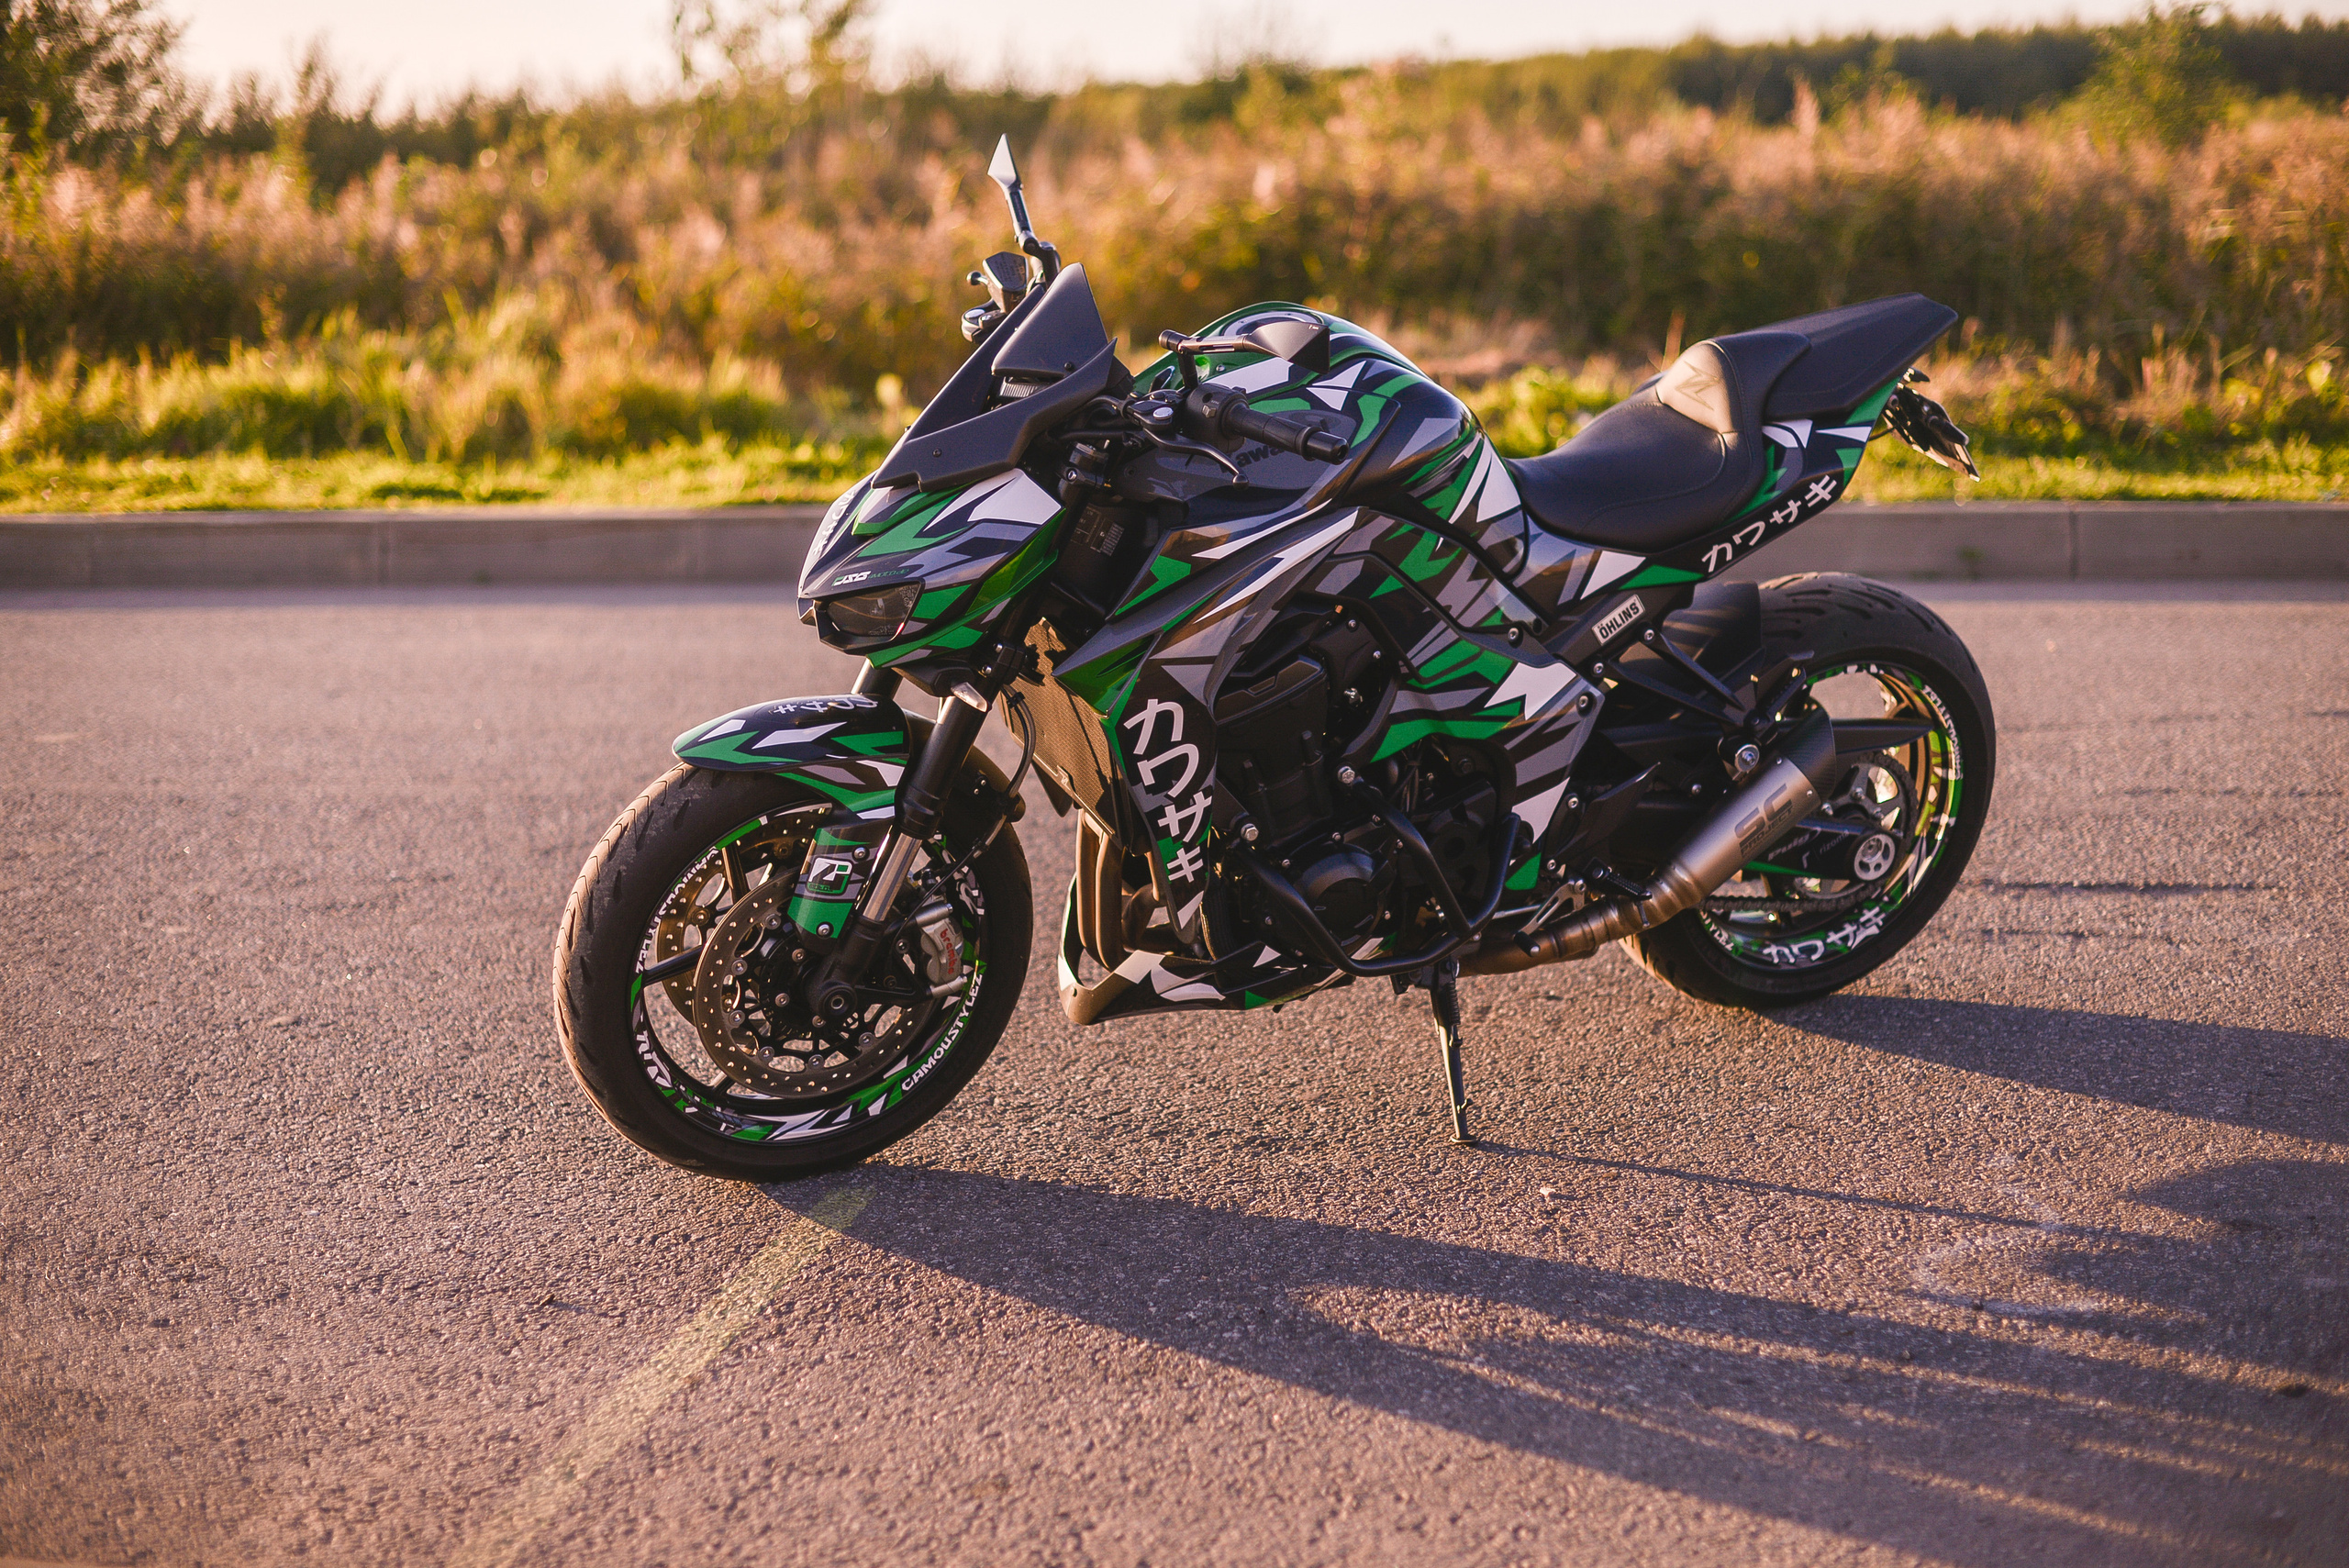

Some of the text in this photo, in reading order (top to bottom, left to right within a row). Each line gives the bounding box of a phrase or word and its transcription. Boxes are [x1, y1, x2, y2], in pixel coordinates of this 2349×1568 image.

[1701, 474, 1837, 573] カワサキ
[1597, 602, 1640, 639] ÖHLINS
[1123, 698, 1213, 884] カワサキ
[1734, 783, 1793, 839] SC
[1741, 806, 1793, 858] PROJECT
[940, 928, 958, 975] brembo
[901, 973, 983, 1091] CAMOUSTYLEZ
